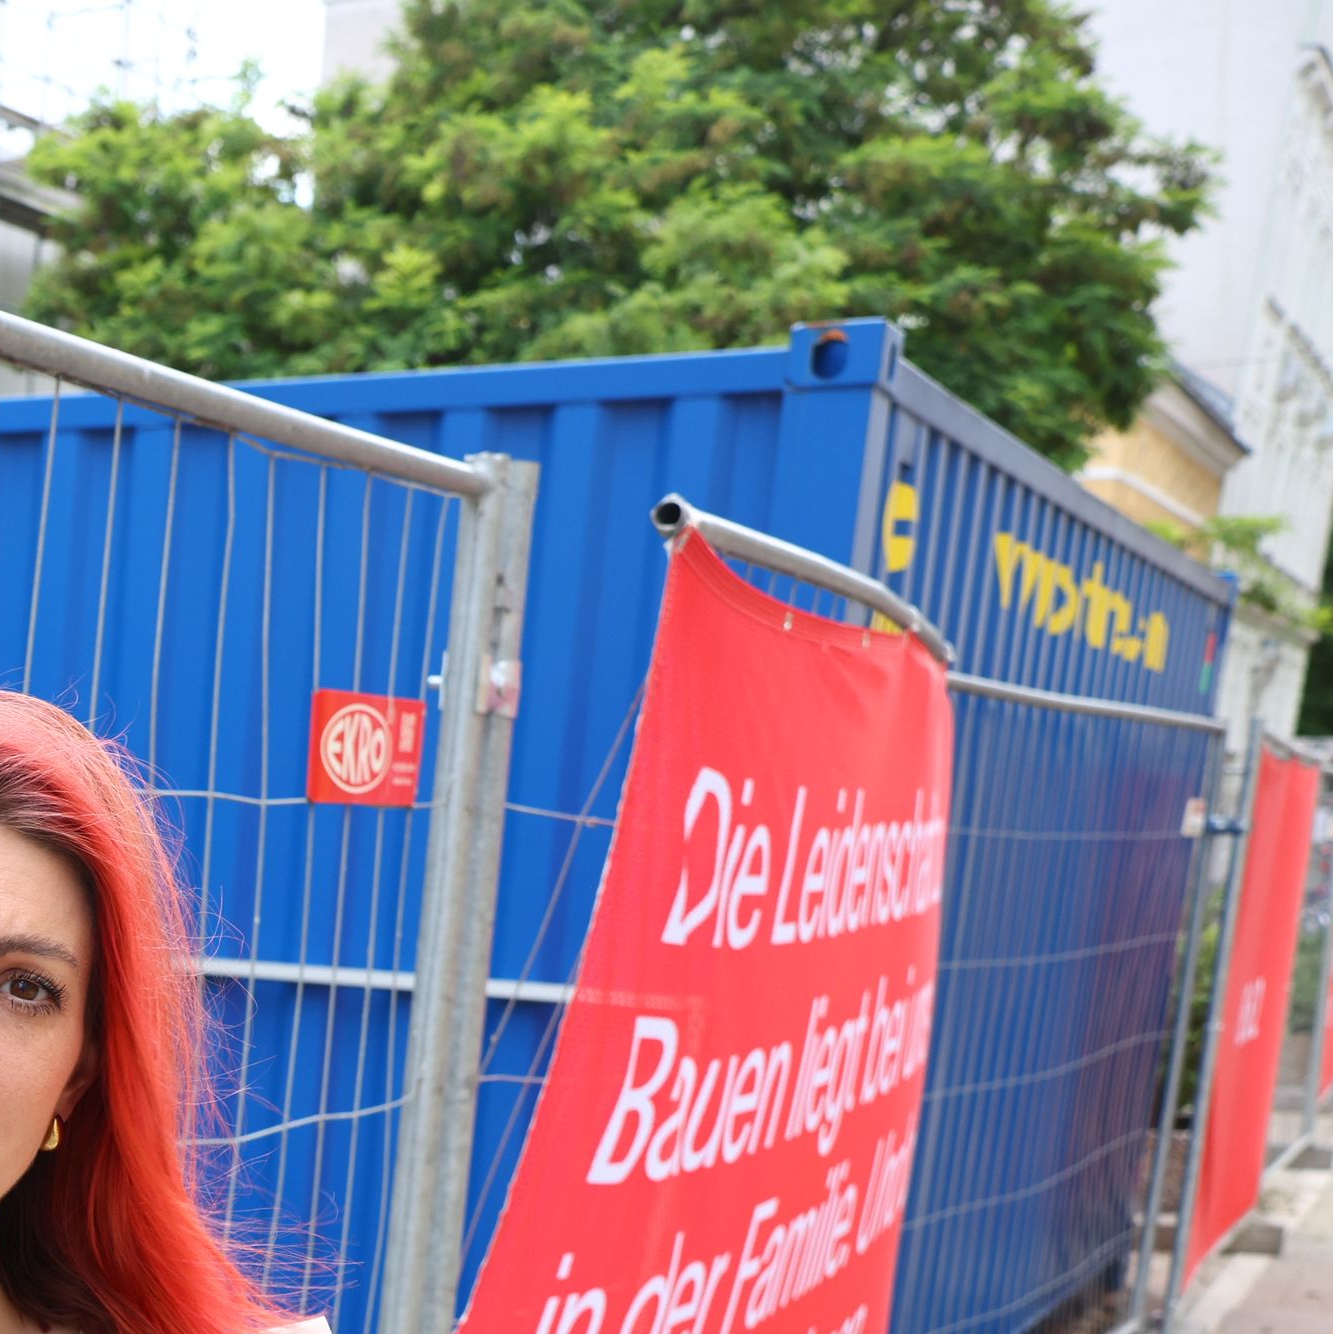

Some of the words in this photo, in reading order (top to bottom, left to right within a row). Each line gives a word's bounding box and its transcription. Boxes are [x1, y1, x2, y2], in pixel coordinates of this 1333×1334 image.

[326, 711, 386, 785] EKRO
[660, 765, 771, 950] Die
[586, 1015, 793, 1184] Bauen
[785, 994, 870, 1157] liegt
